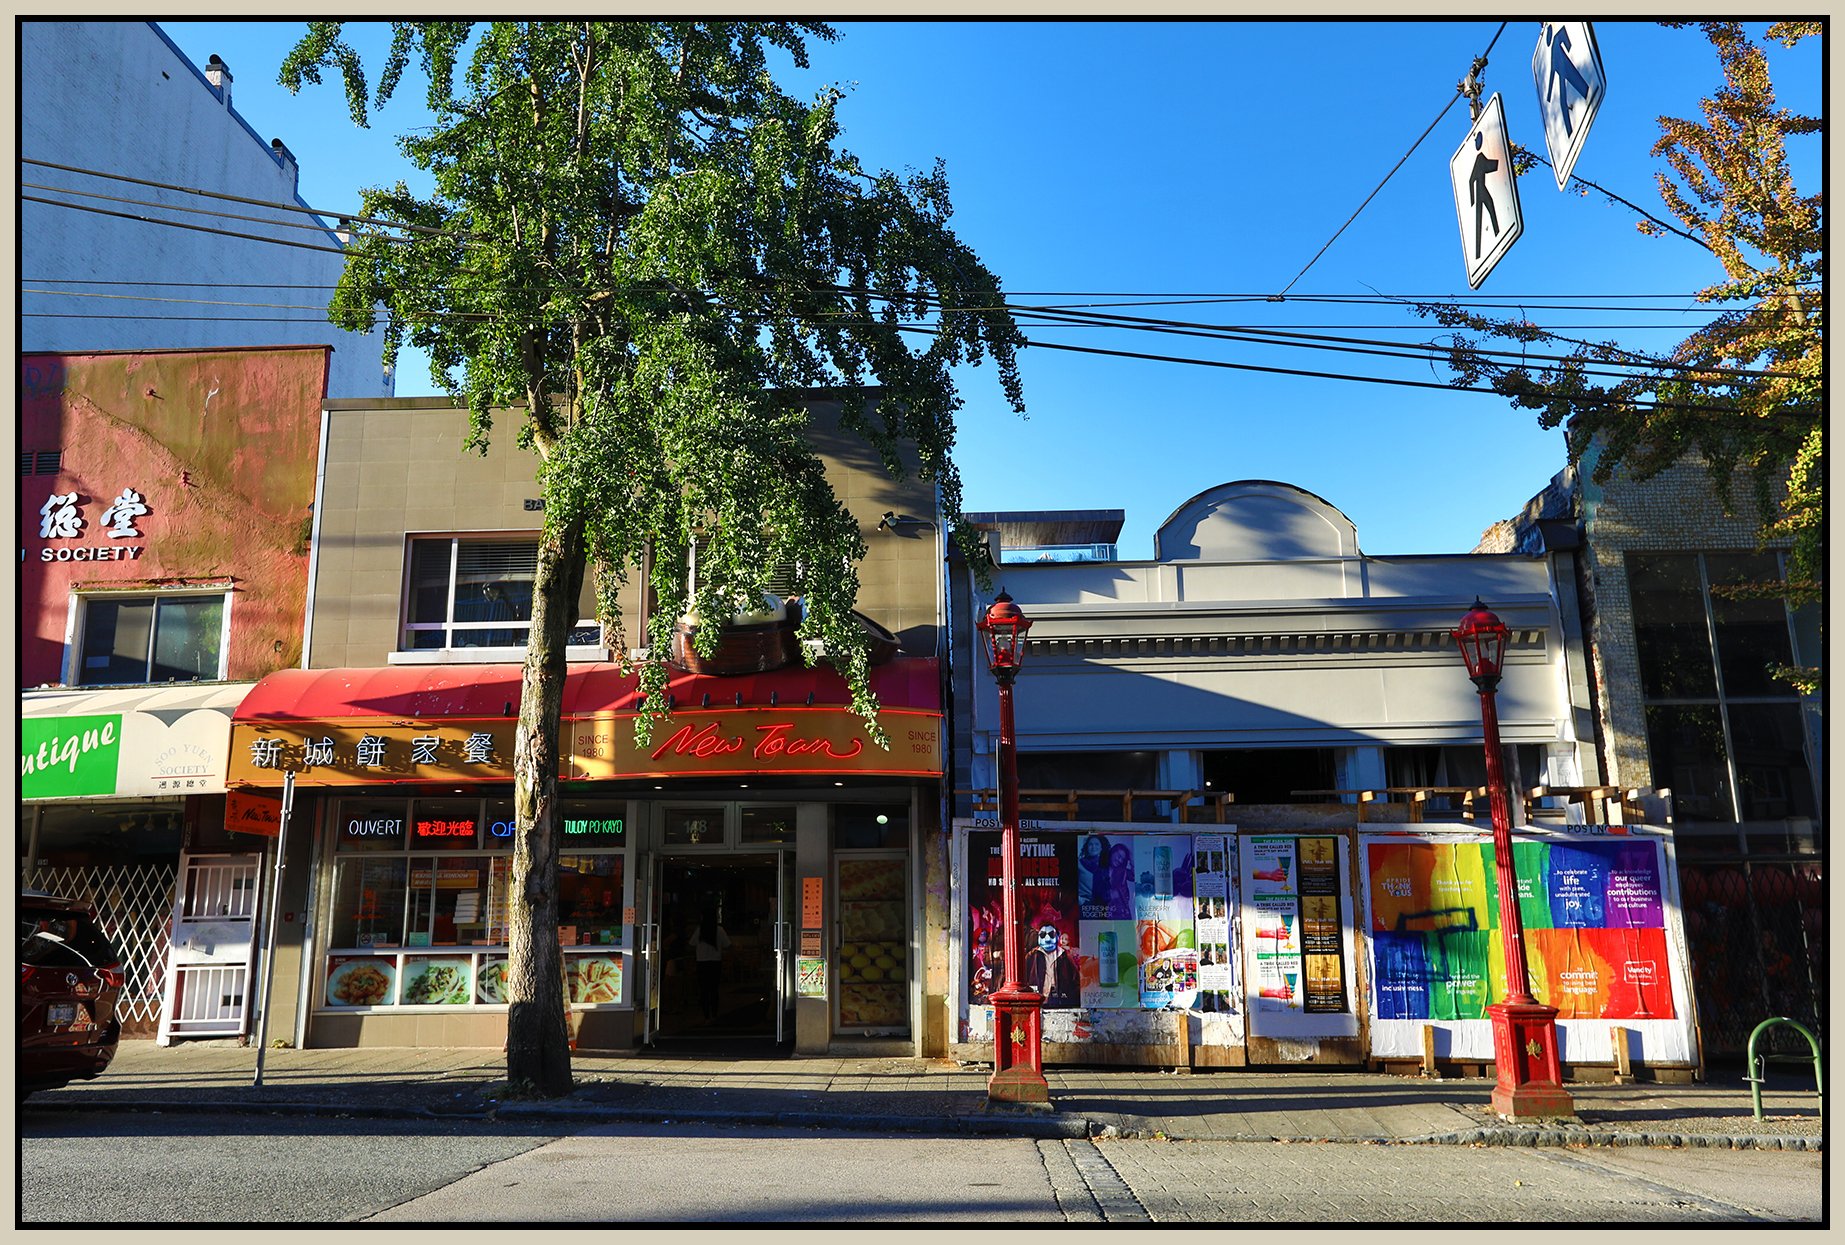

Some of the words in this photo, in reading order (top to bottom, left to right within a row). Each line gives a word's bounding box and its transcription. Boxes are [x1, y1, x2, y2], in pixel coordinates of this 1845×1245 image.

[41, 546, 139, 562] SOCIETY
[578, 734, 609, 745] SINCE
[651, 721, 745, 761] New
[908, 730, 937, 742] SINCE
[583, 747, 605, 758] 1980
[911, 743, 932, 754] 1980
[155, 746, 177, 767] SOO
[184, 743, 214, 764] YUEN
[160, 765, 209, 775] SOCIETY
[348, 820, 402, 836] OUVERT
[417, 820, 474, 837] 歡迎光臨
[564, 820, 588, 834] TULOY
[602, 820, 623, 834] KAYO
[1020, 820, 1041, 829] BILL
[1567, 824, 1593, 834] POST
[990, 846, 1000, 855] THE
[1025, 878, 1035, 887] ALL
[1563, 876, 1580, 885] life
[1607, 888, 1658, 896] contributions
[1565, 898, 1582, 910] joy.
[1560, 971, 1598, 979] commit
[1446, 980, 1476, 991] power
[1563, 985, 1598, 995] language.
